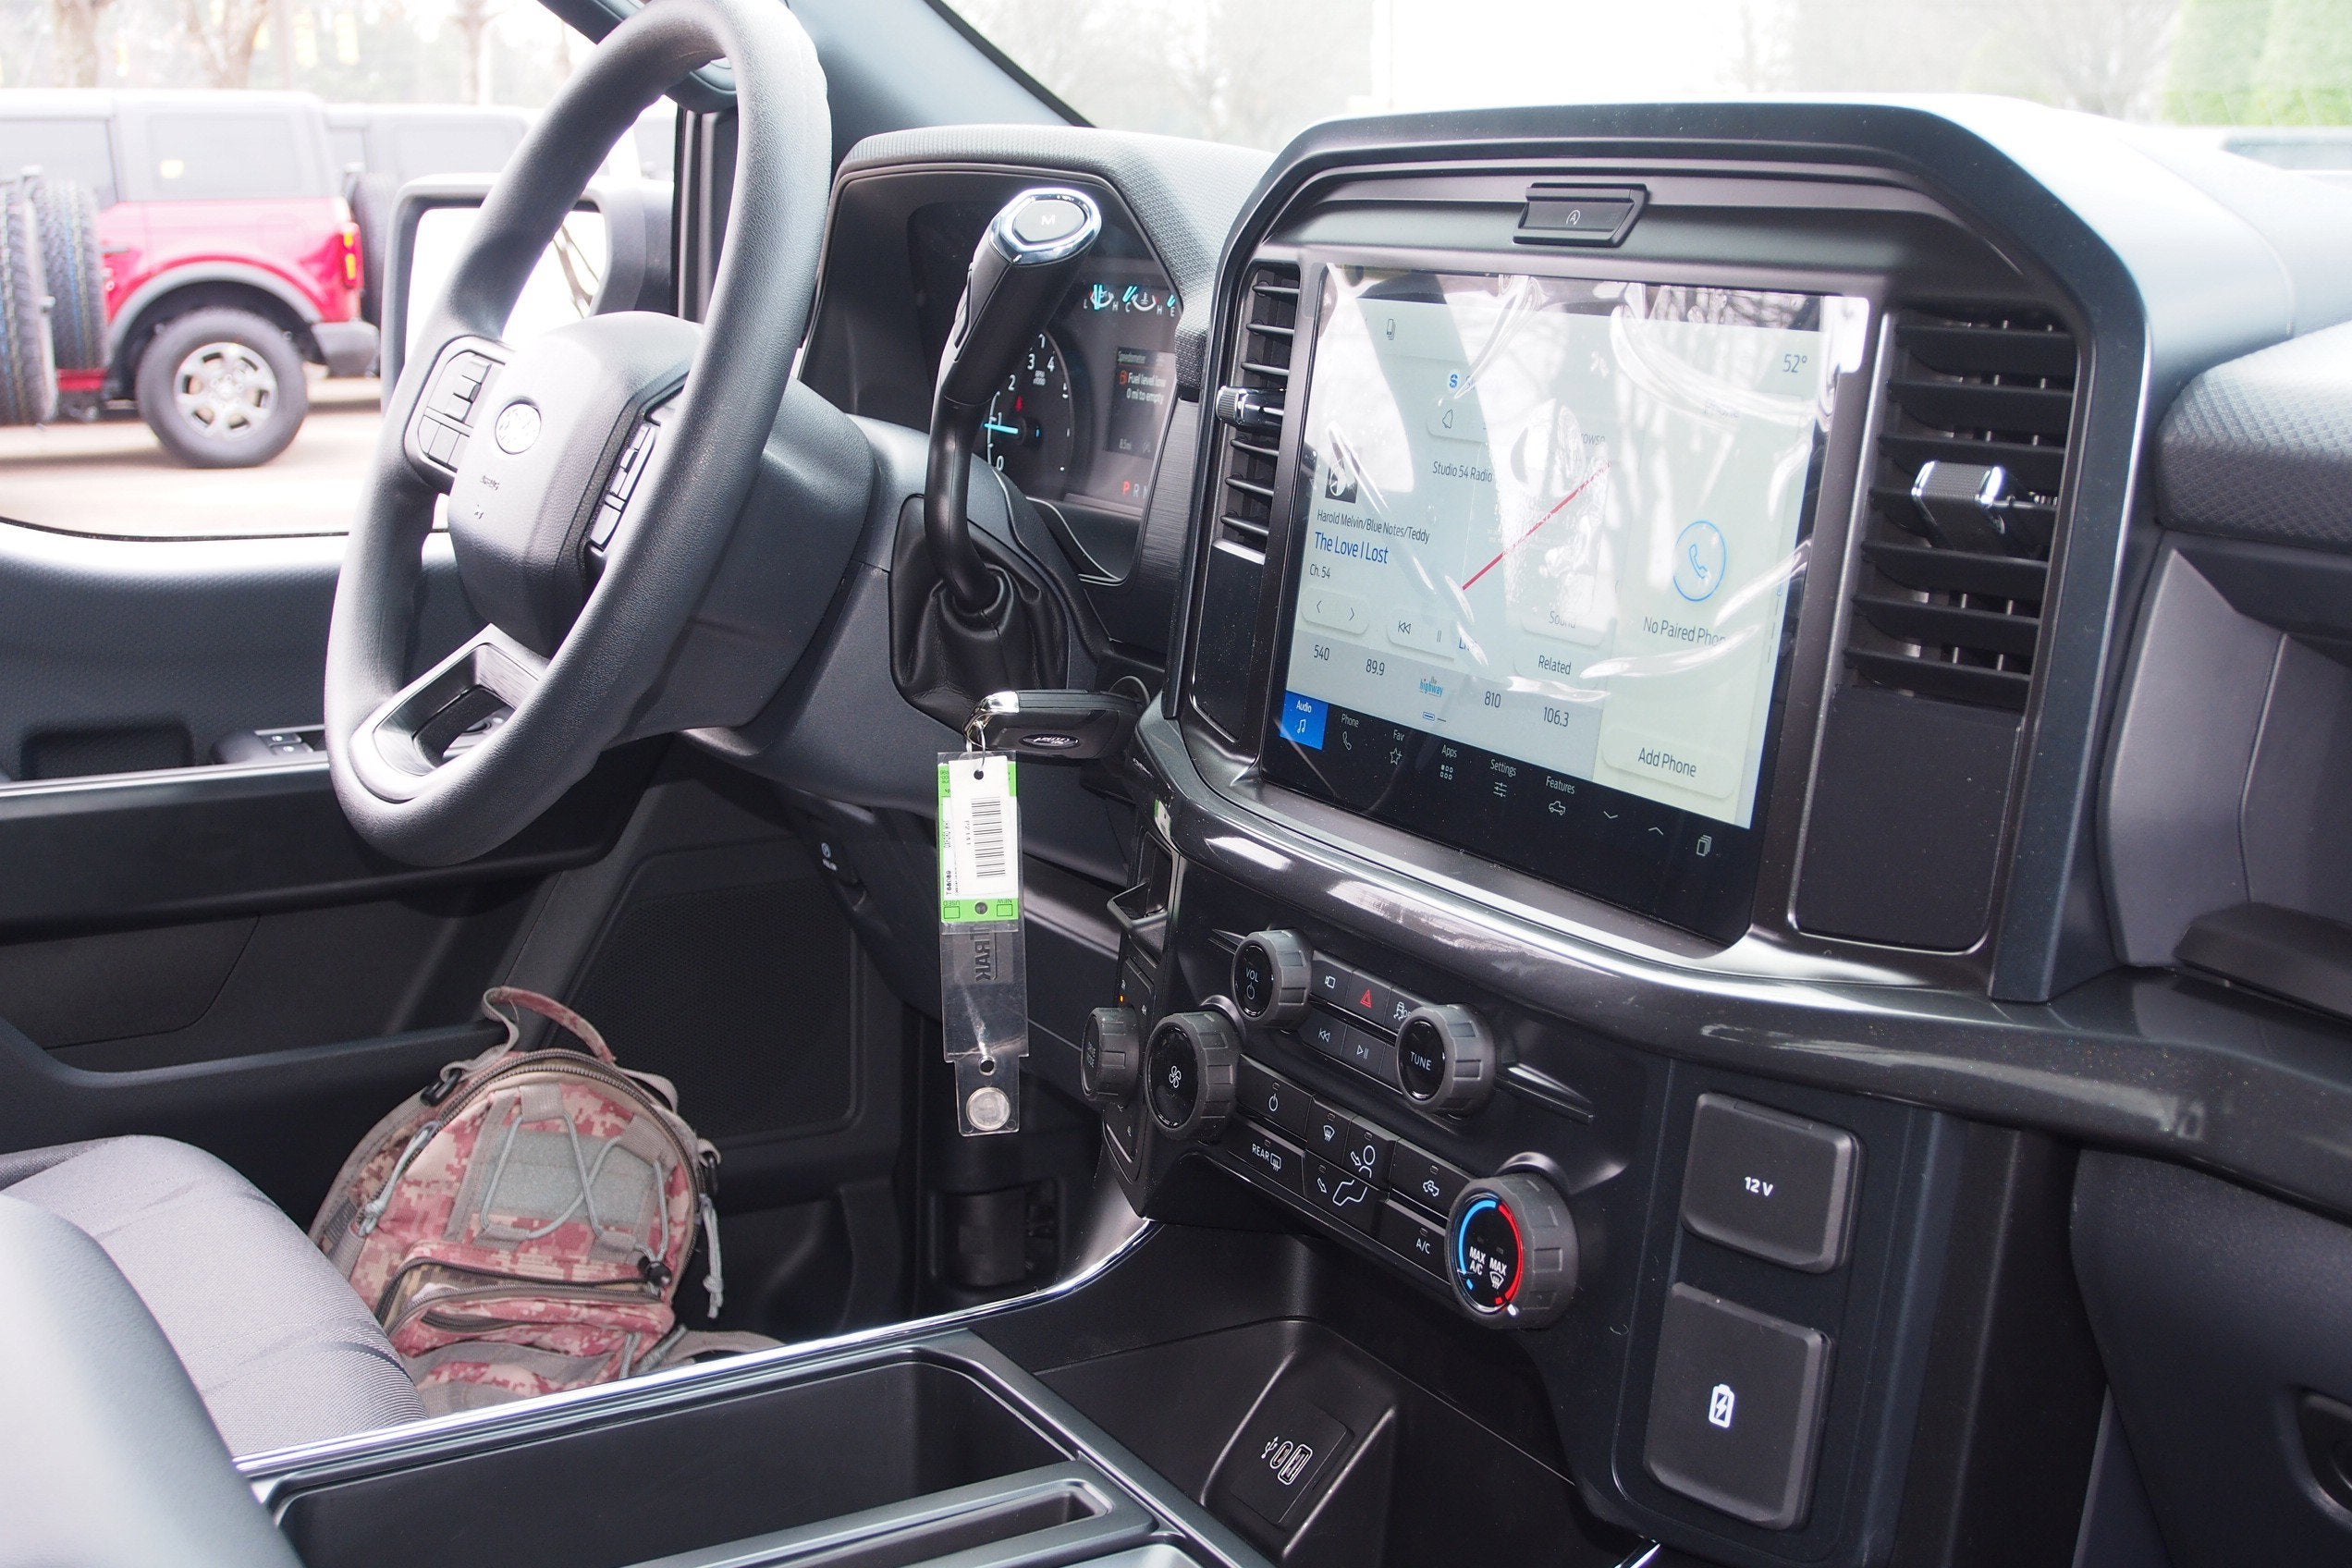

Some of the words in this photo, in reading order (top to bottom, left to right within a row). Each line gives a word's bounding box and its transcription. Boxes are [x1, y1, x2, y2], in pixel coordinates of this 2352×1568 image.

[1041, 214, 1056, 227] M
[1157, 304, 1163, 315] H
[1170, 306, 1176, 317] E
[1027, 353, 1035, 370] 3
[1047, 356, 1055, 372] 4
[1008, 374, 1016, 391] 2
[997, 455, 1004, 472] 0
[1432, 460, 1458, 478] Studio
[1459, 464, 1469, 479] 54
[1470, 466, 1493, 483] Radio
[1122, 481, 1131, 496] P
[1317, 508, 1340, 525] Harold
[1341, 513, 1382, 534] Melvin/Blue
[1383, 522, 1430, 545] Notes/Teddy
[1315, 531, 1332, 551] The
[1334, 535, 1359, 557] Love
[1366, 542, 1389, 564] Lost
[1309, 563, 1320, 578] Ch.
[1321, 565, 1331, 580] 54
[1643, 616, 1658, 635] No
[1660, 619, 1695, 643] Paired
[1313, 644, 1329, 661] 540
[1366, 657, 1385, 677] 89.9
[1538, 655, 1572, 676] Related
[1295, 699, 1312, 714] Audio
[1483, 691, 1501, 709] 810
[1341, 713, 1359, 729] Phone
[1543, 705, 1570, 728] 106.3
[1393, 729, 1404, 741] Fav
[1441, 743, 1458, 758] Apps
[1489, 758, 1517, 778] Settings
[1637, 747, 1660, 768] Add
[1662, 753, 1697, 778] Phone
[1545, 775, 1575, 794] Features
[1245, 966, 1259, 983] VOL
[1410, 1051, 1432, 1071] TUNE
[1252, 1143, 1269, 1161] REAR
[1415, 1237, 1431, 1255] A/C
[1469, 1245, 1486, 1265] MAX
[1469, 1259, 1483, 1276] A/C
[1489, 1256, 1507, 1276] MAX
